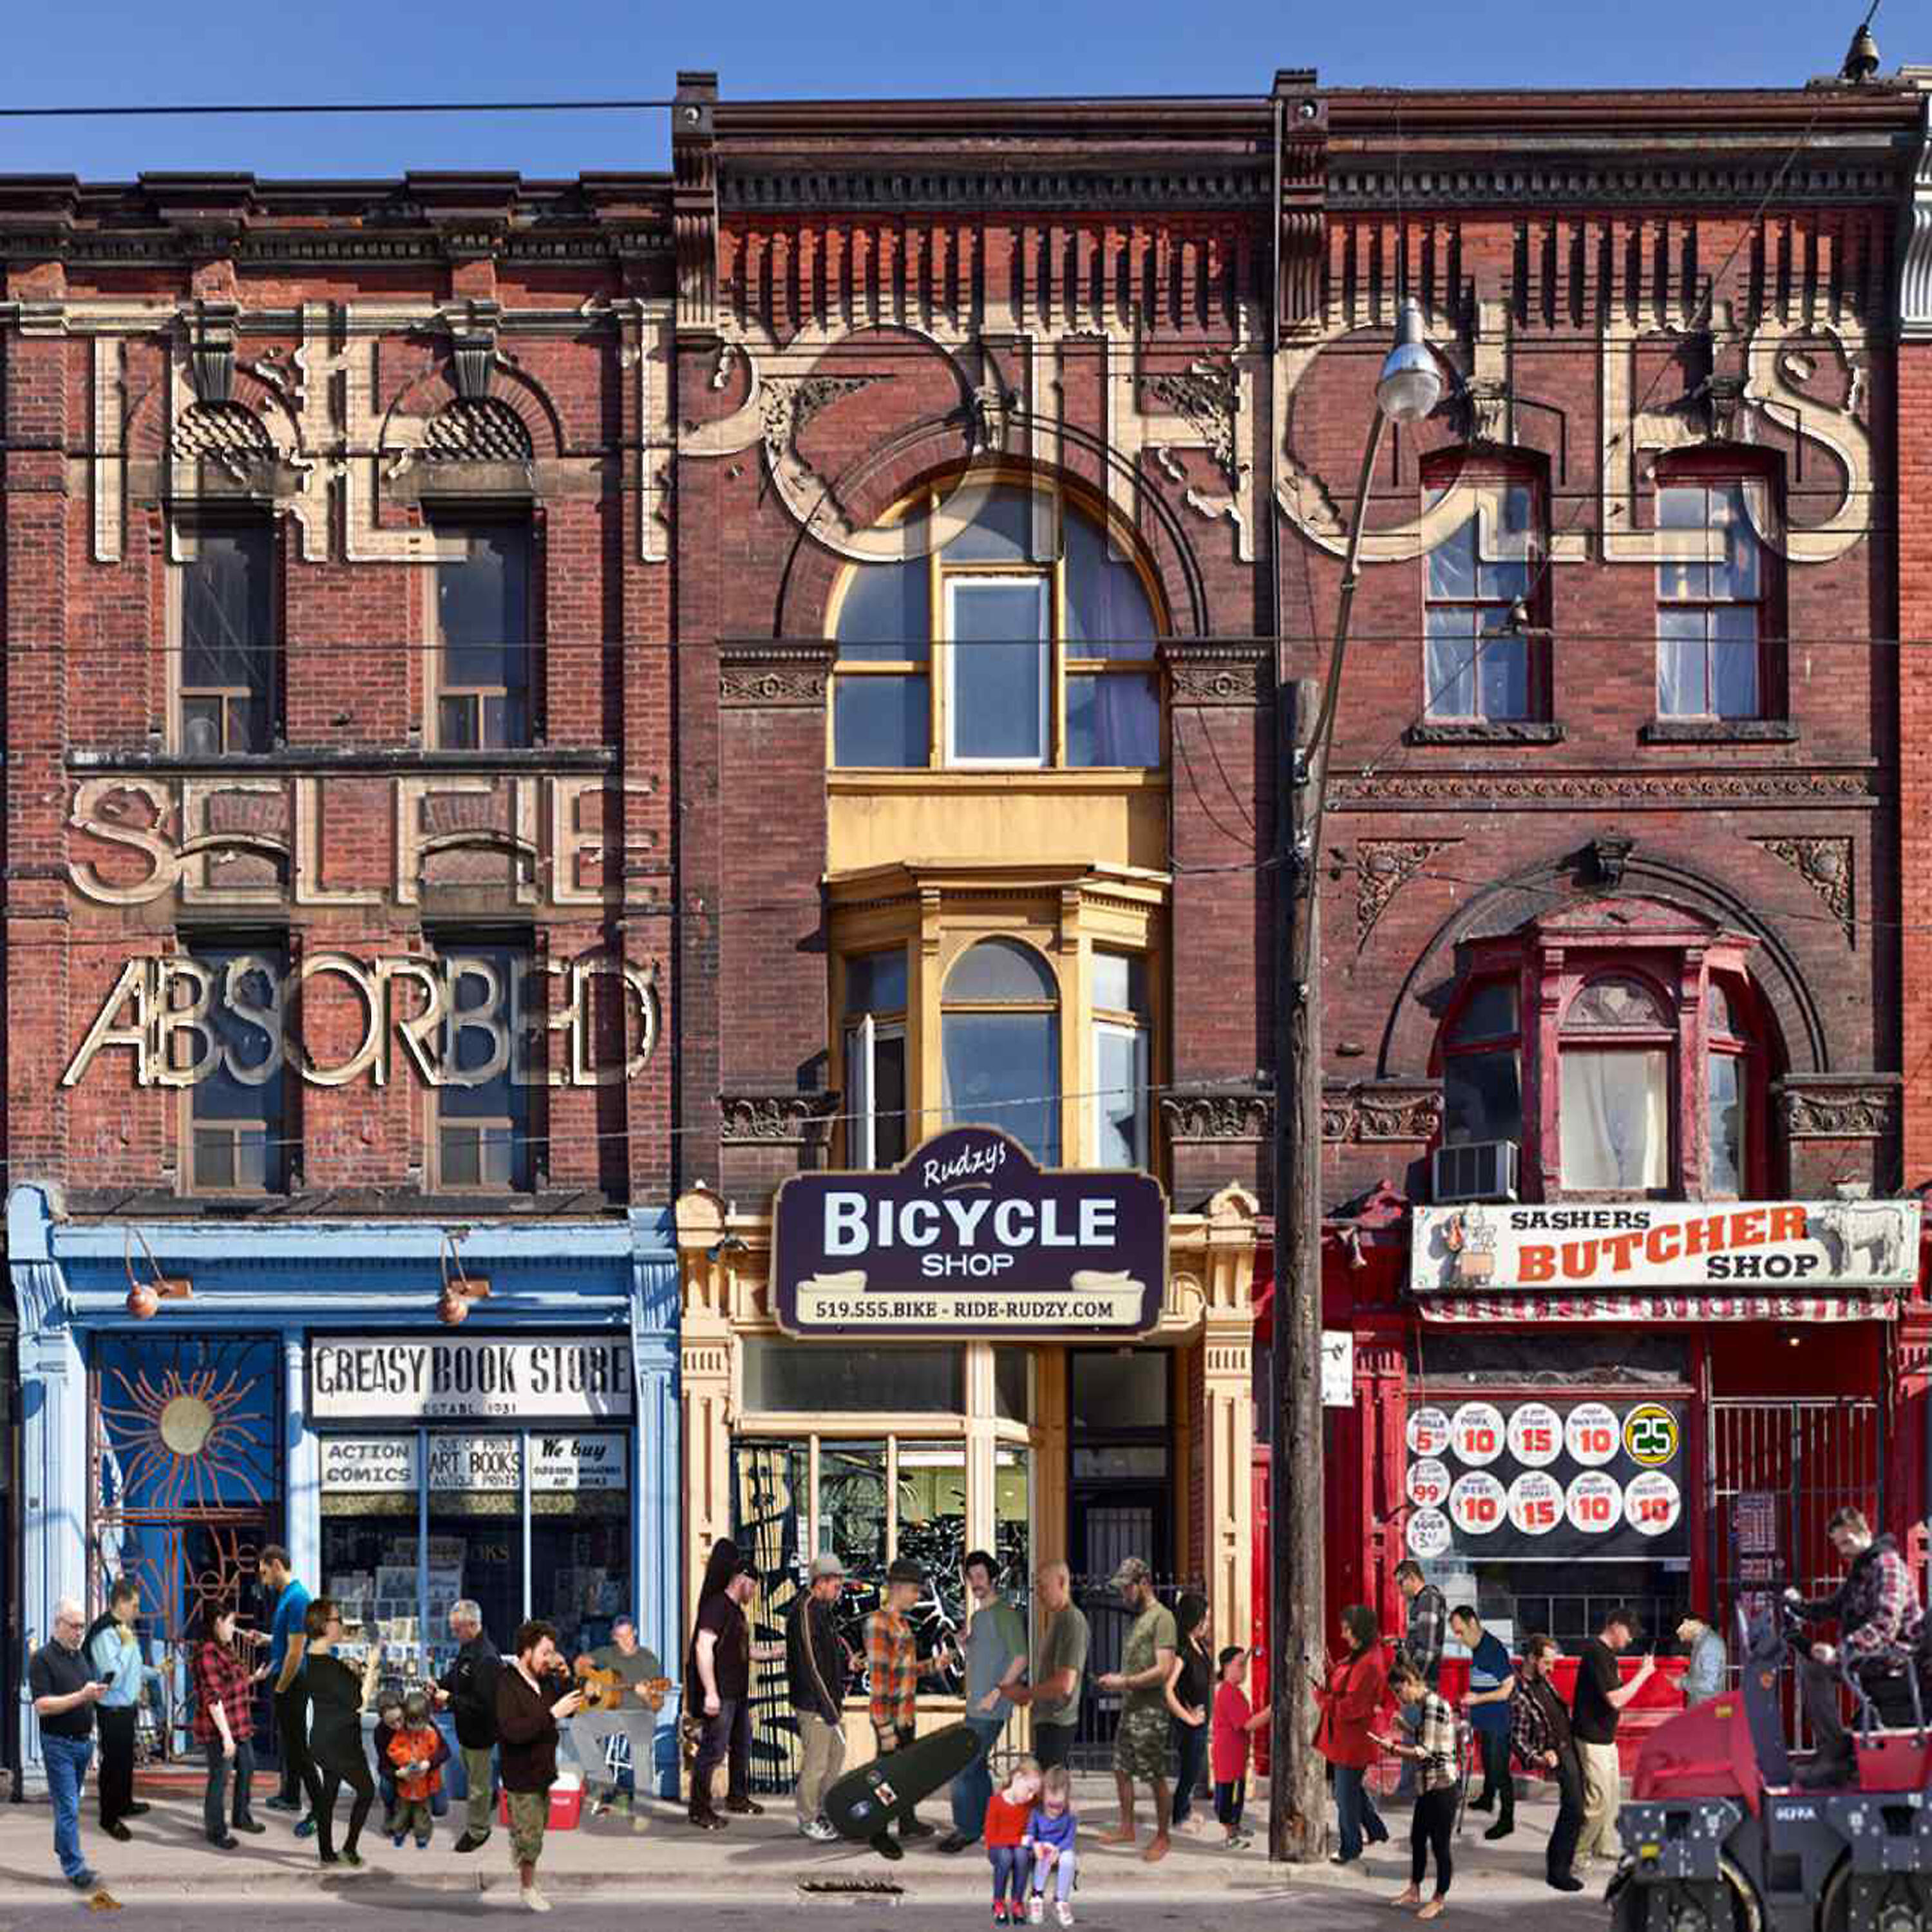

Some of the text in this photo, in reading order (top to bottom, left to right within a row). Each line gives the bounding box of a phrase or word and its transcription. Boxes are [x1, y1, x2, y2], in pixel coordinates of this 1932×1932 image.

[923, 1142, 1007, 1188] Rudzys
[1510, 1211, 1651, 1231] SASHERS
[1517, 1205, 1808, 1282] BUTCHER
[921, 1254, 1015, 1277] SHOP
[1707, 1255, 1819, 1278] SHOP
[815, 1301, 938, 1318] 519.555.BIKE
[954, 1301, 1113, 1319] RIDE-RUDZY.COM
[314, 1346, 630, 1397] GREASY BOOK STORE
[1633, 1418, 1671, 1454] 25
[328, 1444, 410, 1459] ACTION
[542, 1438, 607, 1462] We buy
[327, 1467, 412, 1482] COMICS
[429, 1452, 459, 1474] ART
[469, 1452, 520, 1475] BOOKS
